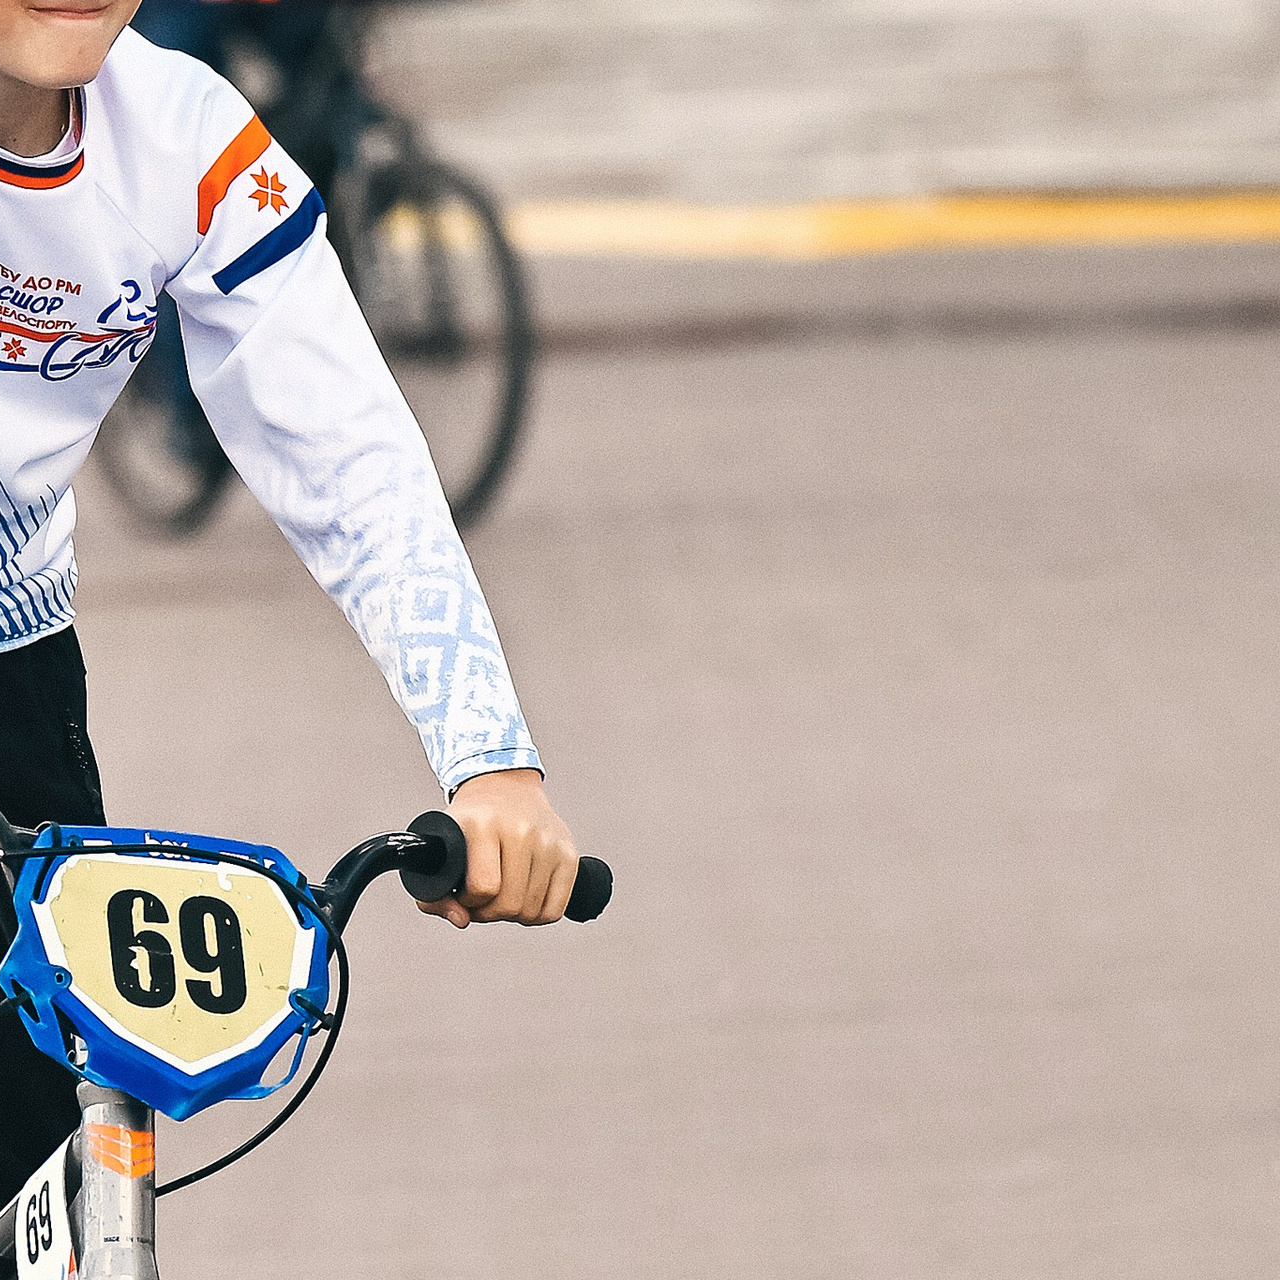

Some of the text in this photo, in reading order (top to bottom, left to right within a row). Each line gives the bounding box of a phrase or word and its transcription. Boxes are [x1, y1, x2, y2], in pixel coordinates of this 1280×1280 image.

[22, 276, 53, 291] ДО
[56, 279, 81, 295] РМ
[106, 888, 246, 1014] 69
[26, 1180, 53, 1264] 69
